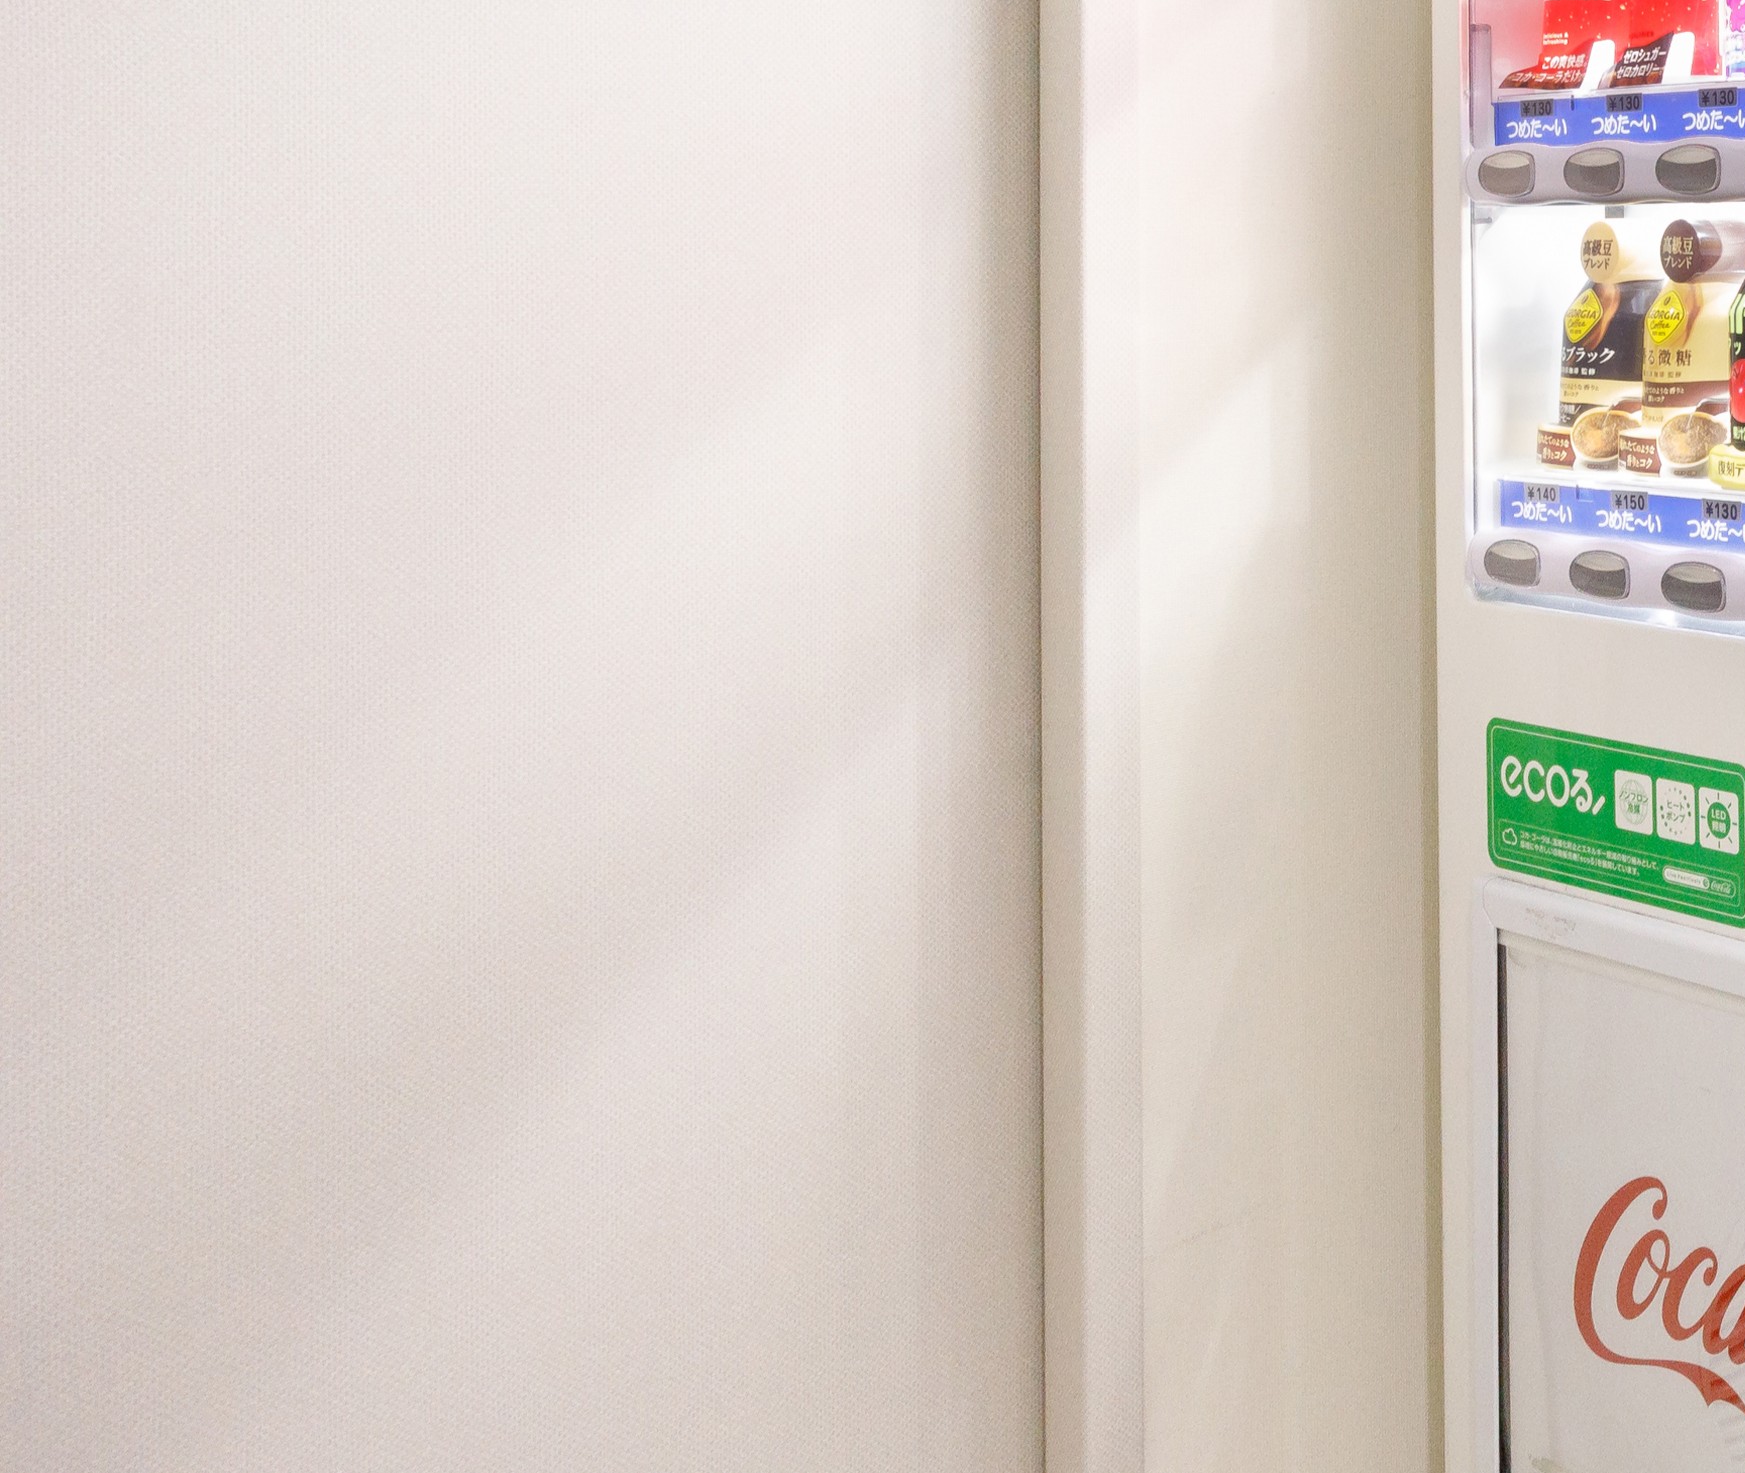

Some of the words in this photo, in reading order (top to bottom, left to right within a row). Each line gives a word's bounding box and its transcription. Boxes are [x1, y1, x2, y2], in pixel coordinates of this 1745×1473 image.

[1623, 47, 1667, 64] ゼロシュガー
[1610, 95, 1640, 111] ¥130
[1702, 90, 1734, 106] ¥130
[1522, 101, 1551, 116] ¥130
[1583, 239, 1613, 257] 高級豆
[1662, 236, 1694, 256] 高級豆
[1583, 257, 1611, 271] ブレンド
[1664, 255, 1692, 270] ブレンド
[1527, 486, 1557, 502] ¥140
[1615, 494, 1645, 511] ¥150
[1705, 501, 1738, 520] ¥130
[1619, 790, 1649, 804] ノンフロン
[1666, 799, 1684, 811] ヒート
[1665, 810, 1686, 824] ポンプ
[1711, 808, 1727, 820] LED
